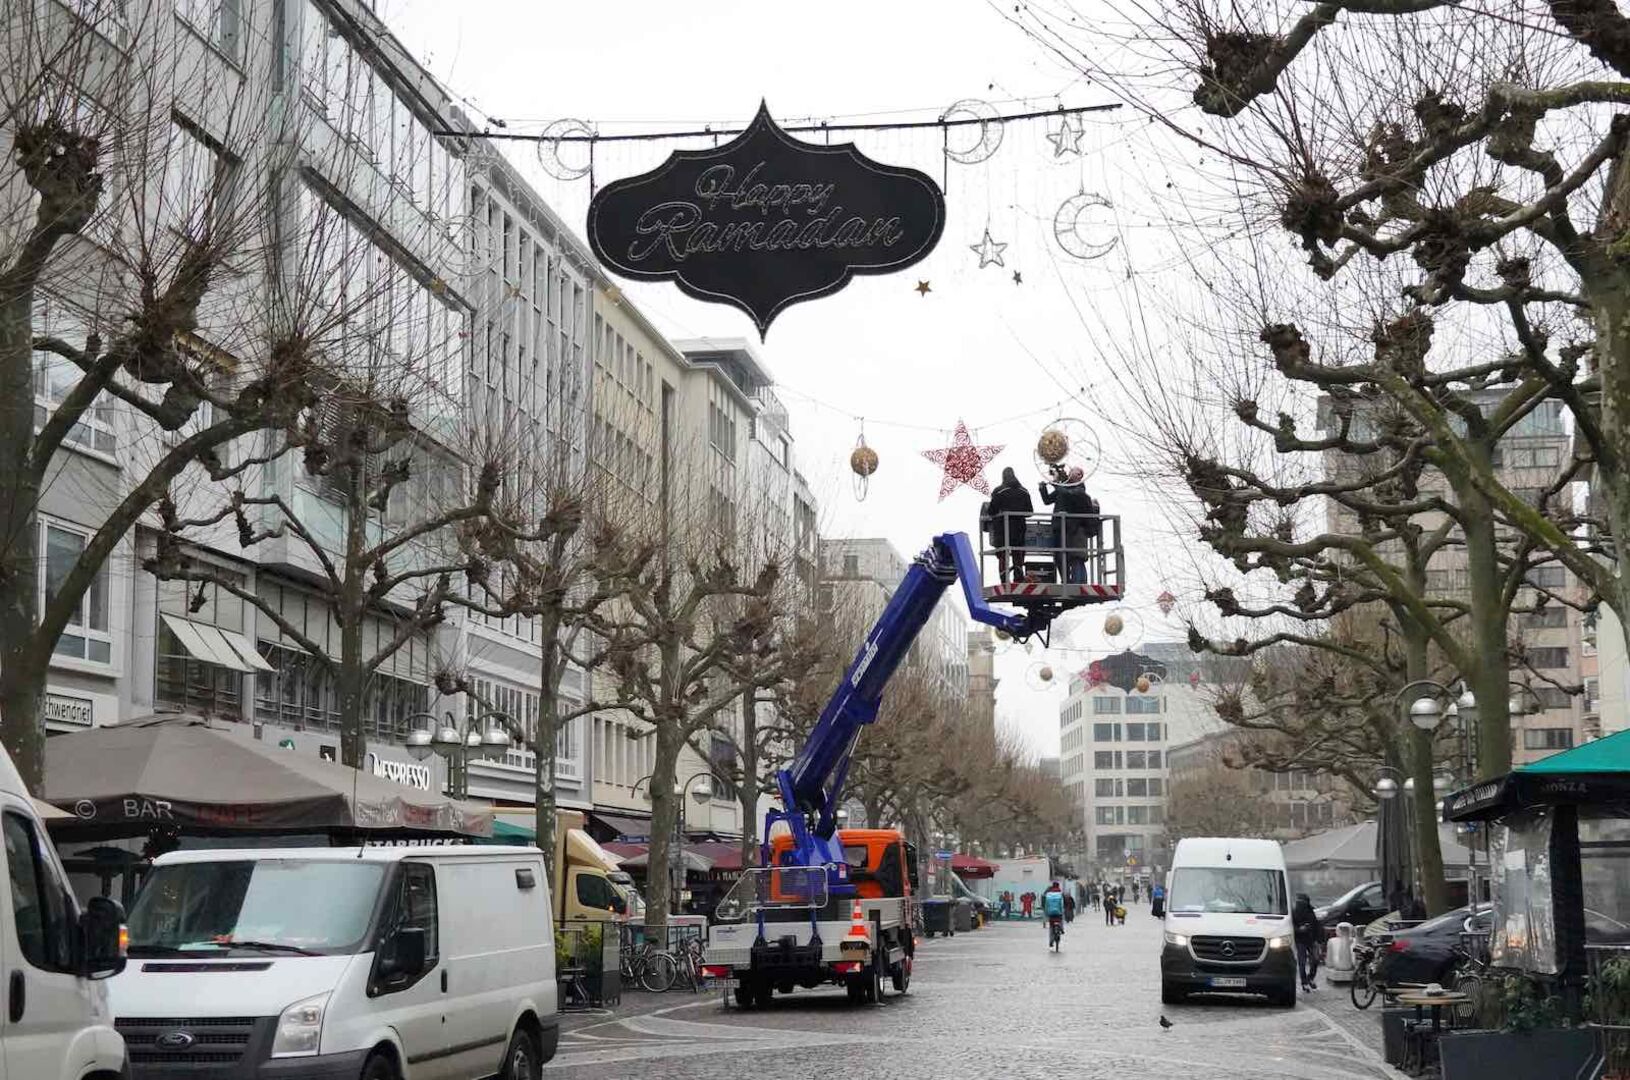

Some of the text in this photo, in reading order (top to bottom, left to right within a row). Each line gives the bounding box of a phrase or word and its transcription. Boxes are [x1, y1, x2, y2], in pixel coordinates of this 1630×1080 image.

[695, 161, 835, 215] Happy
[627, 201, 904, 262] Ramadan
[369, 752, 430, 791] NESPRESSO
[123, 799, 175, 819] BAR
